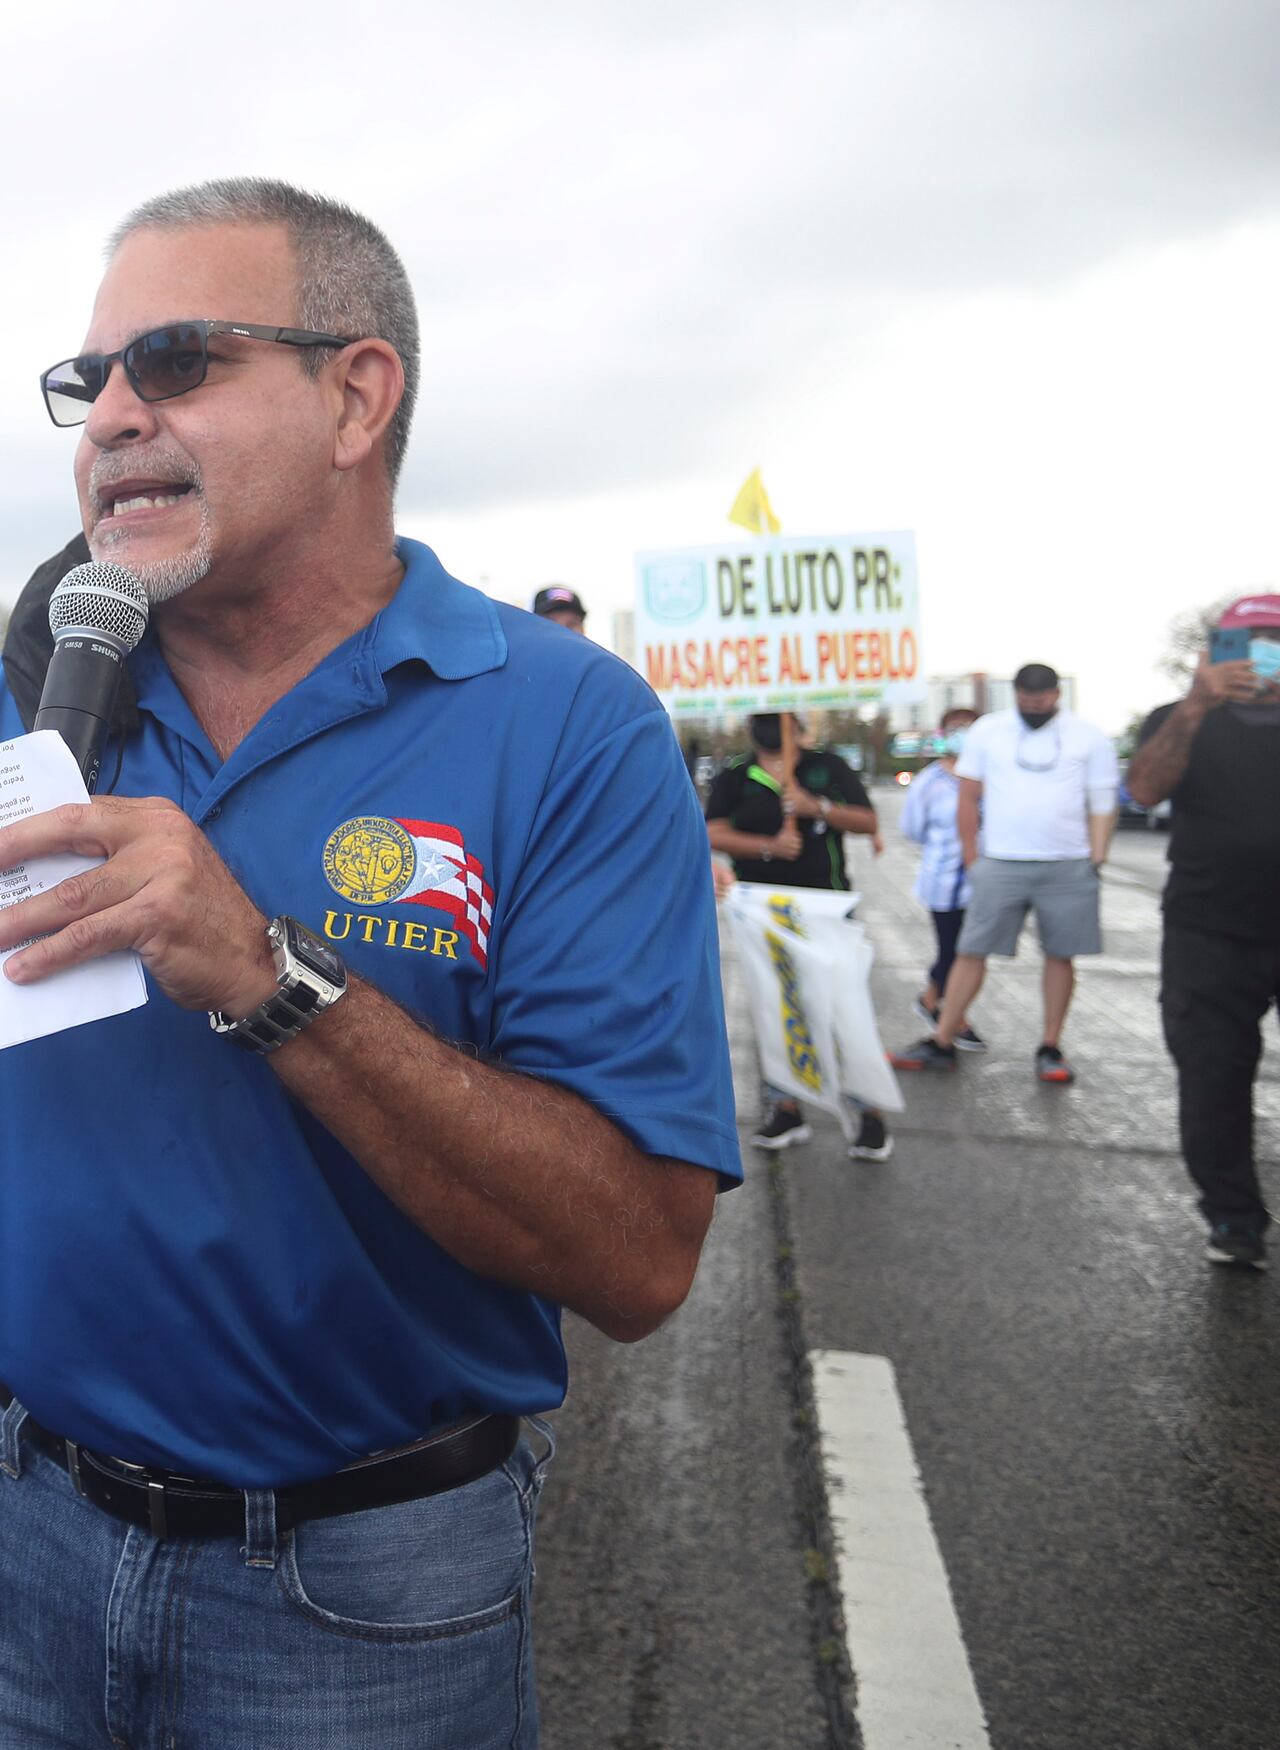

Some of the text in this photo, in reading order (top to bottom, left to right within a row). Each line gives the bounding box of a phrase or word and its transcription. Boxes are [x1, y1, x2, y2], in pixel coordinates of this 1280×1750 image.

[717, 548, 902, 617] DE LUTO PR:
[91, 643, 120, 663] SHURE
[646, 629, 917, 689] MASACRE AL PUEBLO
[2, 774, 24, 787] Pedro
[2, 865, 25, 878] dinero
[11, 886, 31, 898] Luma
[323, 910, 459, 960] UTIER
